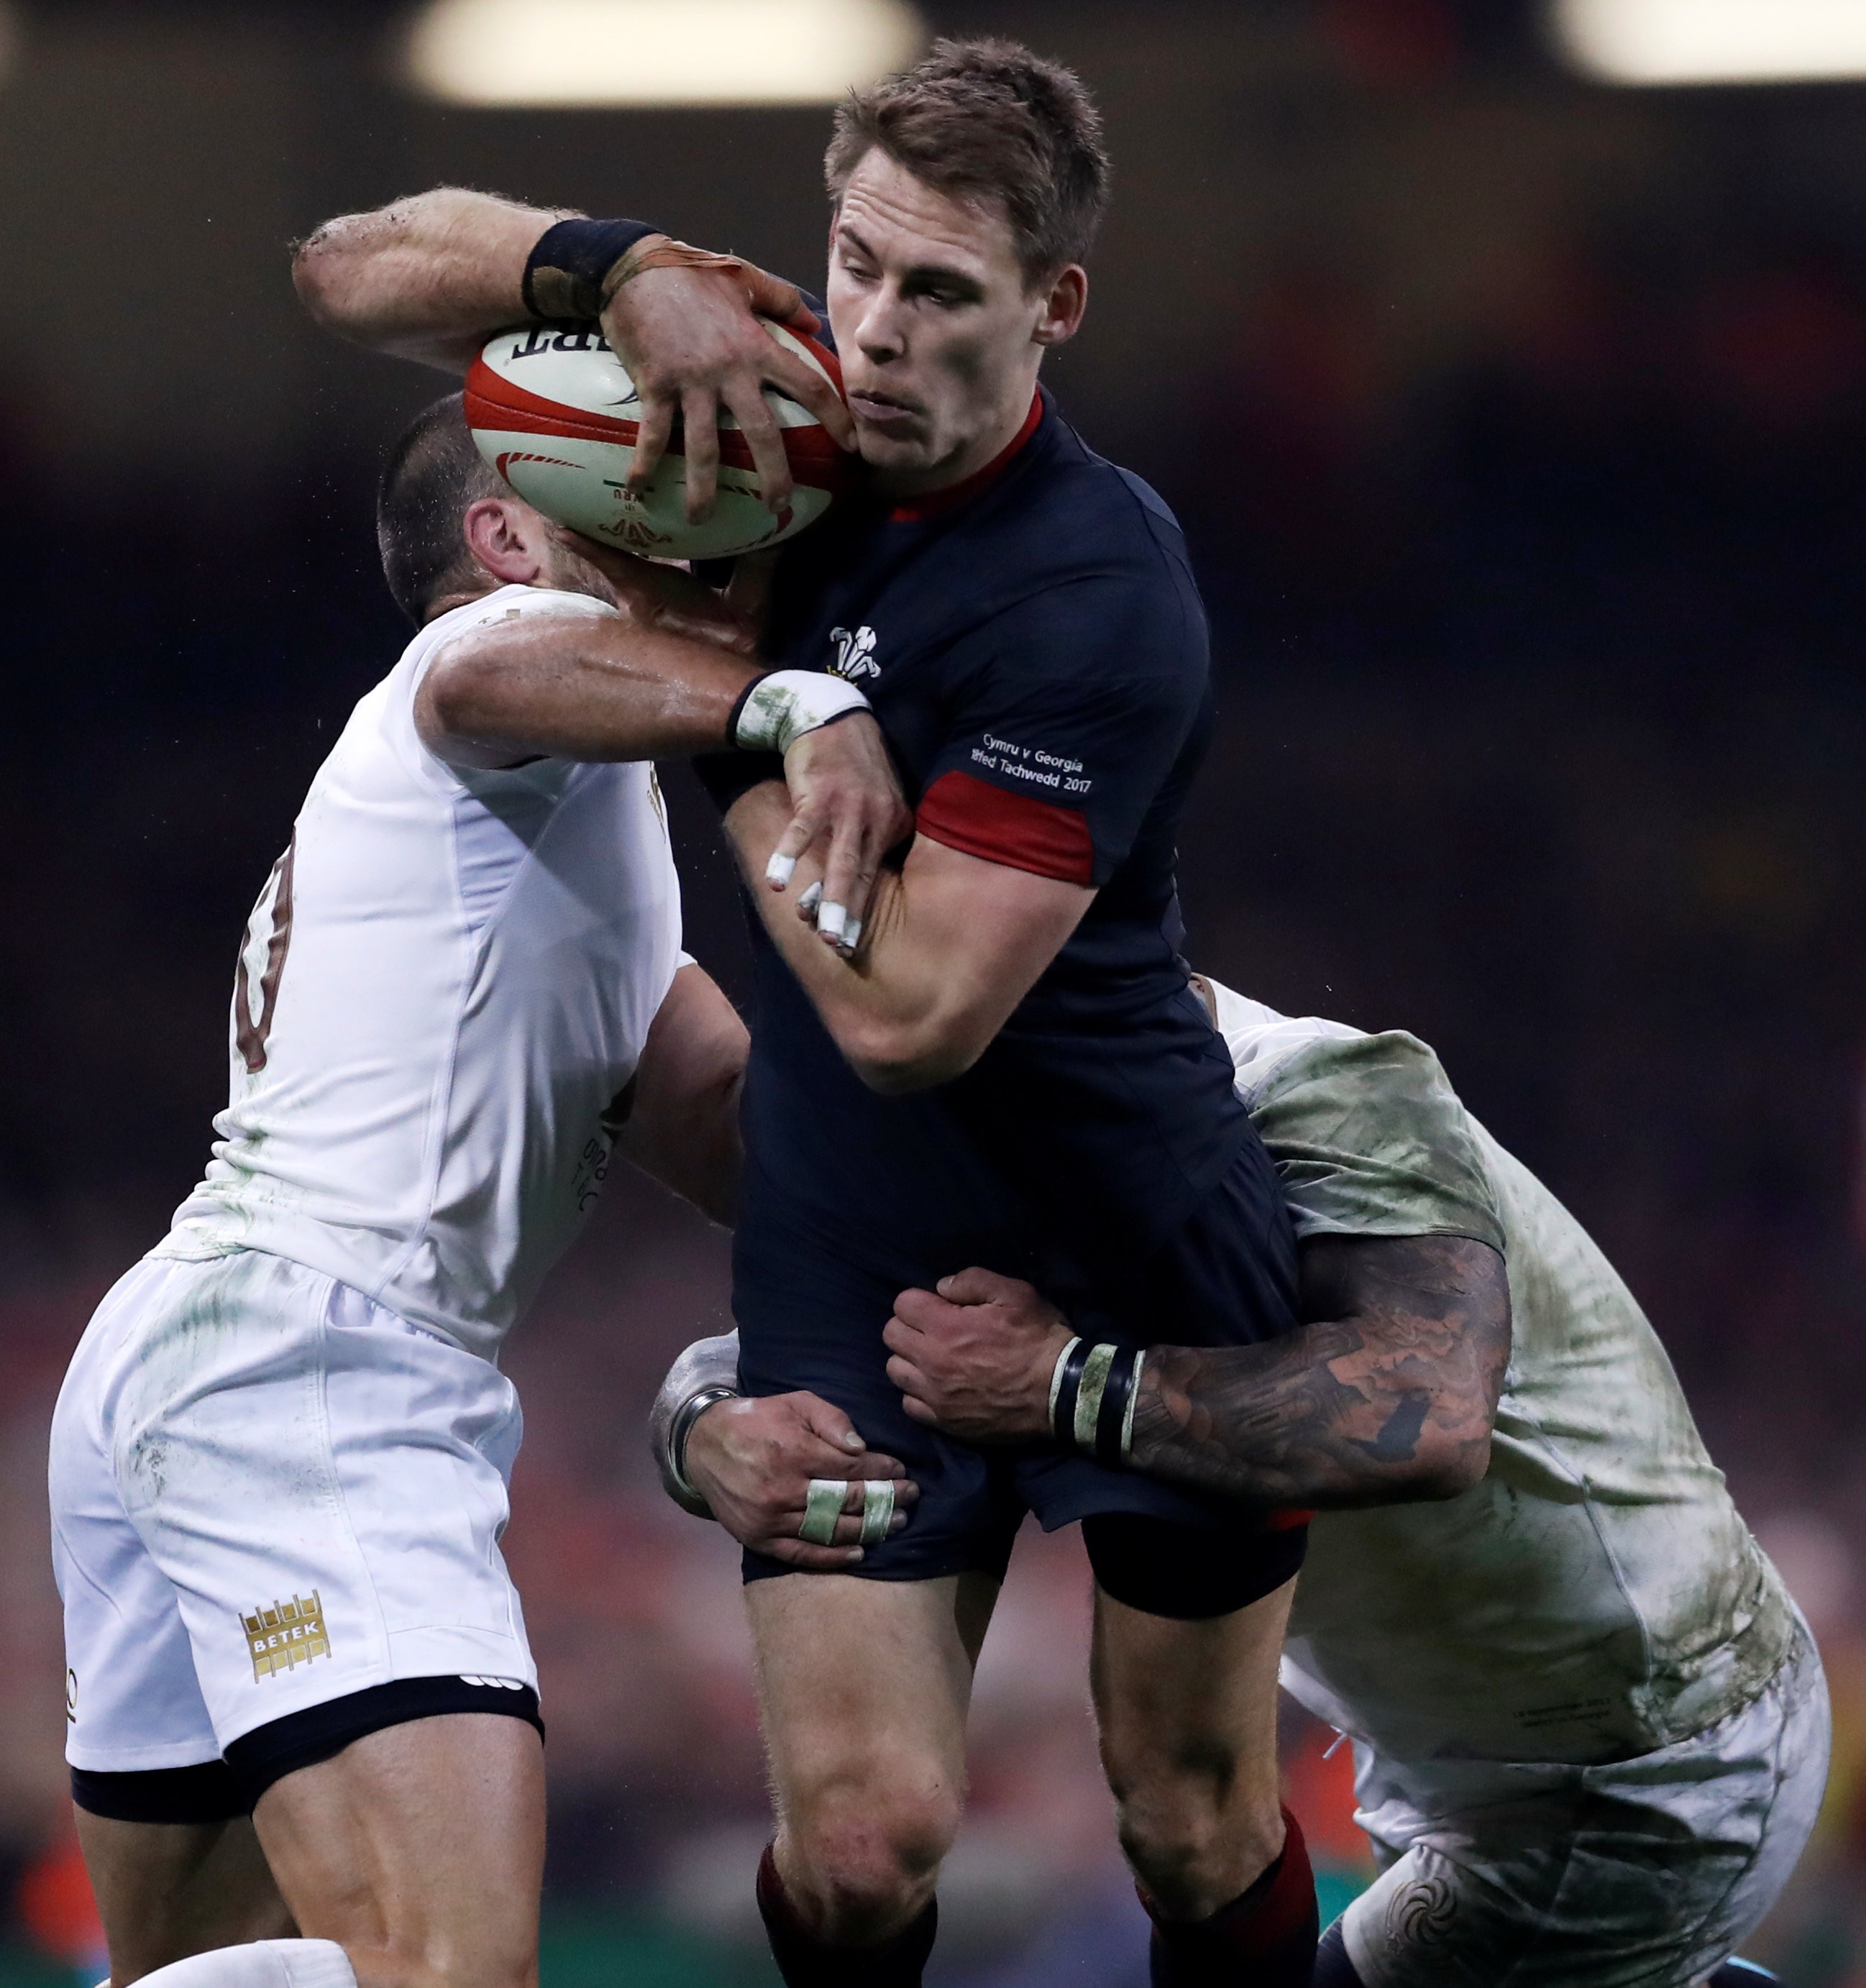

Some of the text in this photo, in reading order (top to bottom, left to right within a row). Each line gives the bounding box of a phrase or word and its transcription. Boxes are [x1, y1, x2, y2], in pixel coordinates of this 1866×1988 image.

[983, 733, 1083, 773] Cymru v Georgia
[1000, 759, 1061, 788] Tachwedd
[1064, 777, 1092, 792] 2017
[253, 1621, 319, 1653] BETEK
